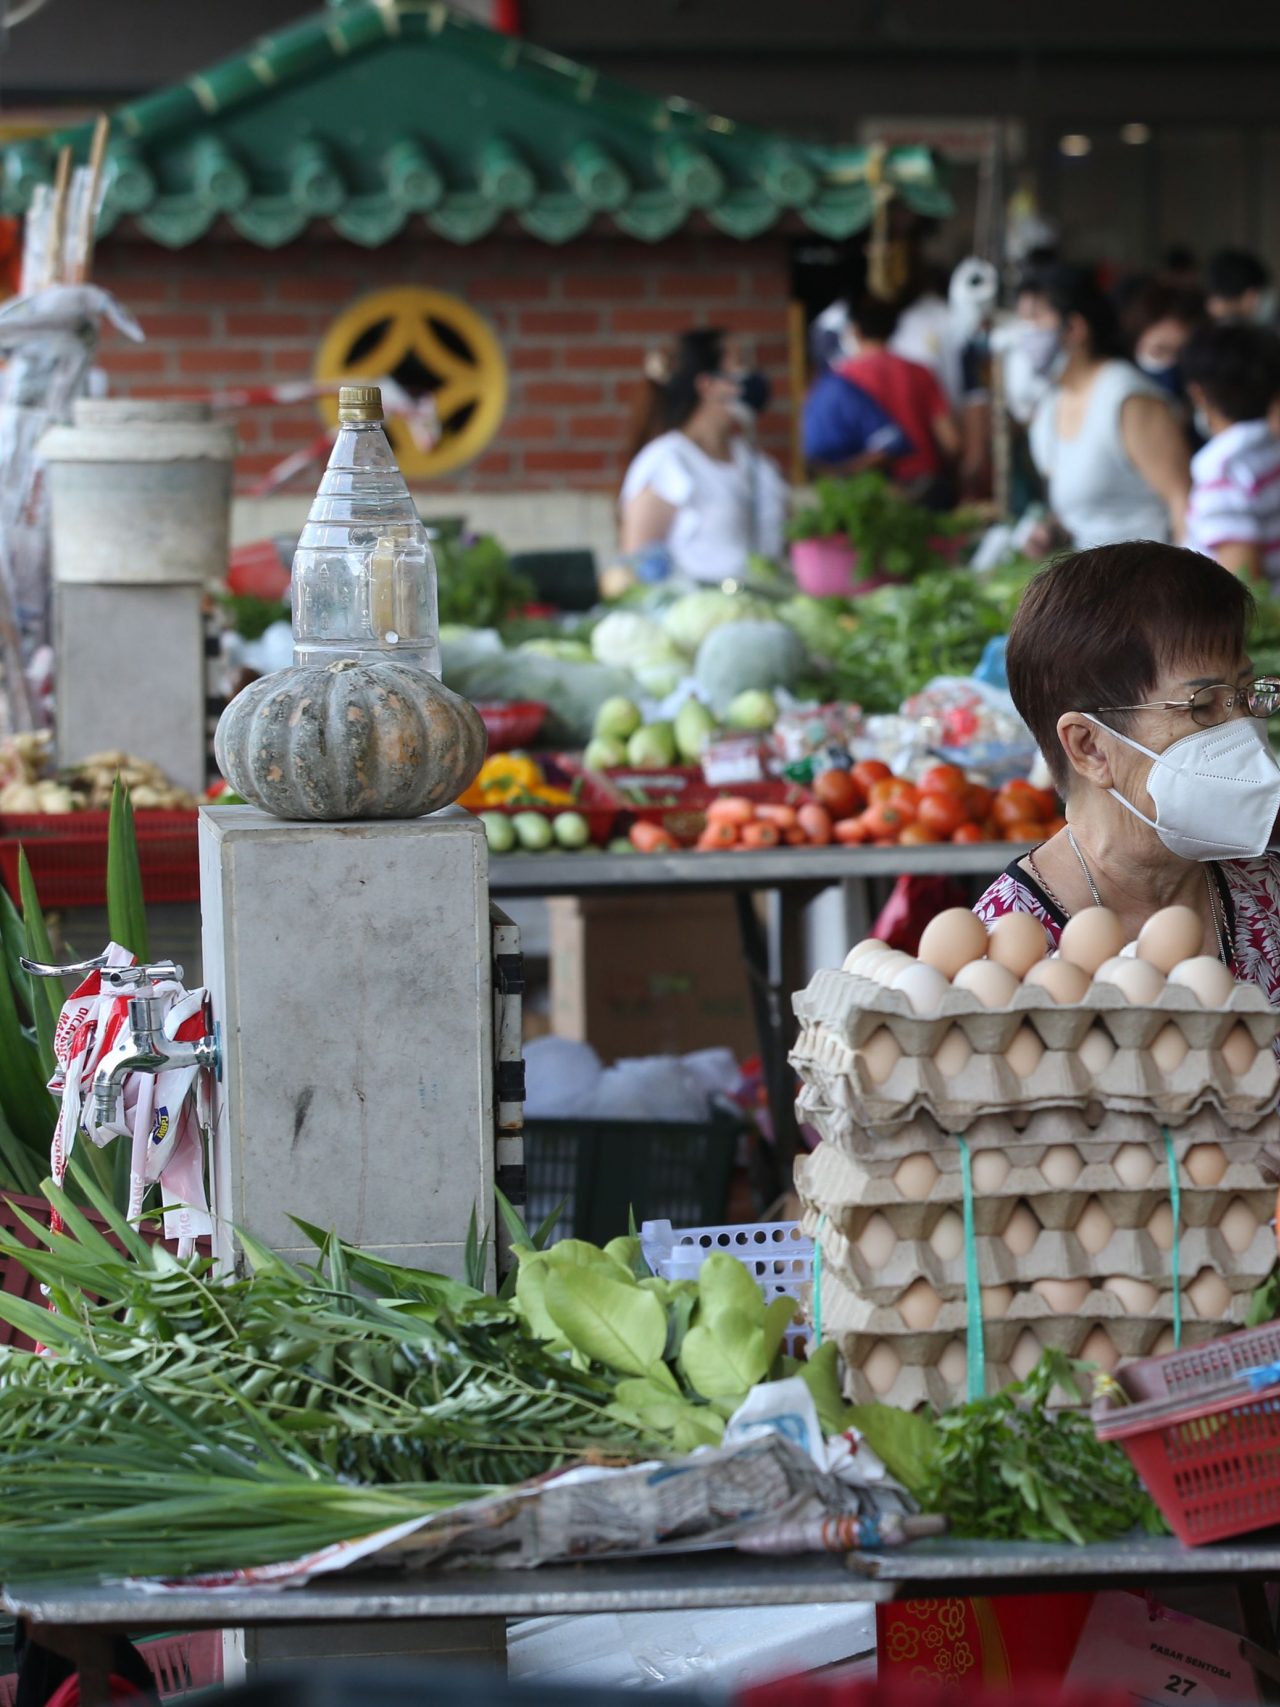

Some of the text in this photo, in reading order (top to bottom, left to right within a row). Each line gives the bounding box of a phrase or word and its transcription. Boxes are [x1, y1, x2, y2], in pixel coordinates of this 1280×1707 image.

[156, 1115, 169, 1139] MBPJ
[1150, 1643, 1232, 1680] PASAR SENTOSA
[1164, 1674, 1198, 1697] 27
